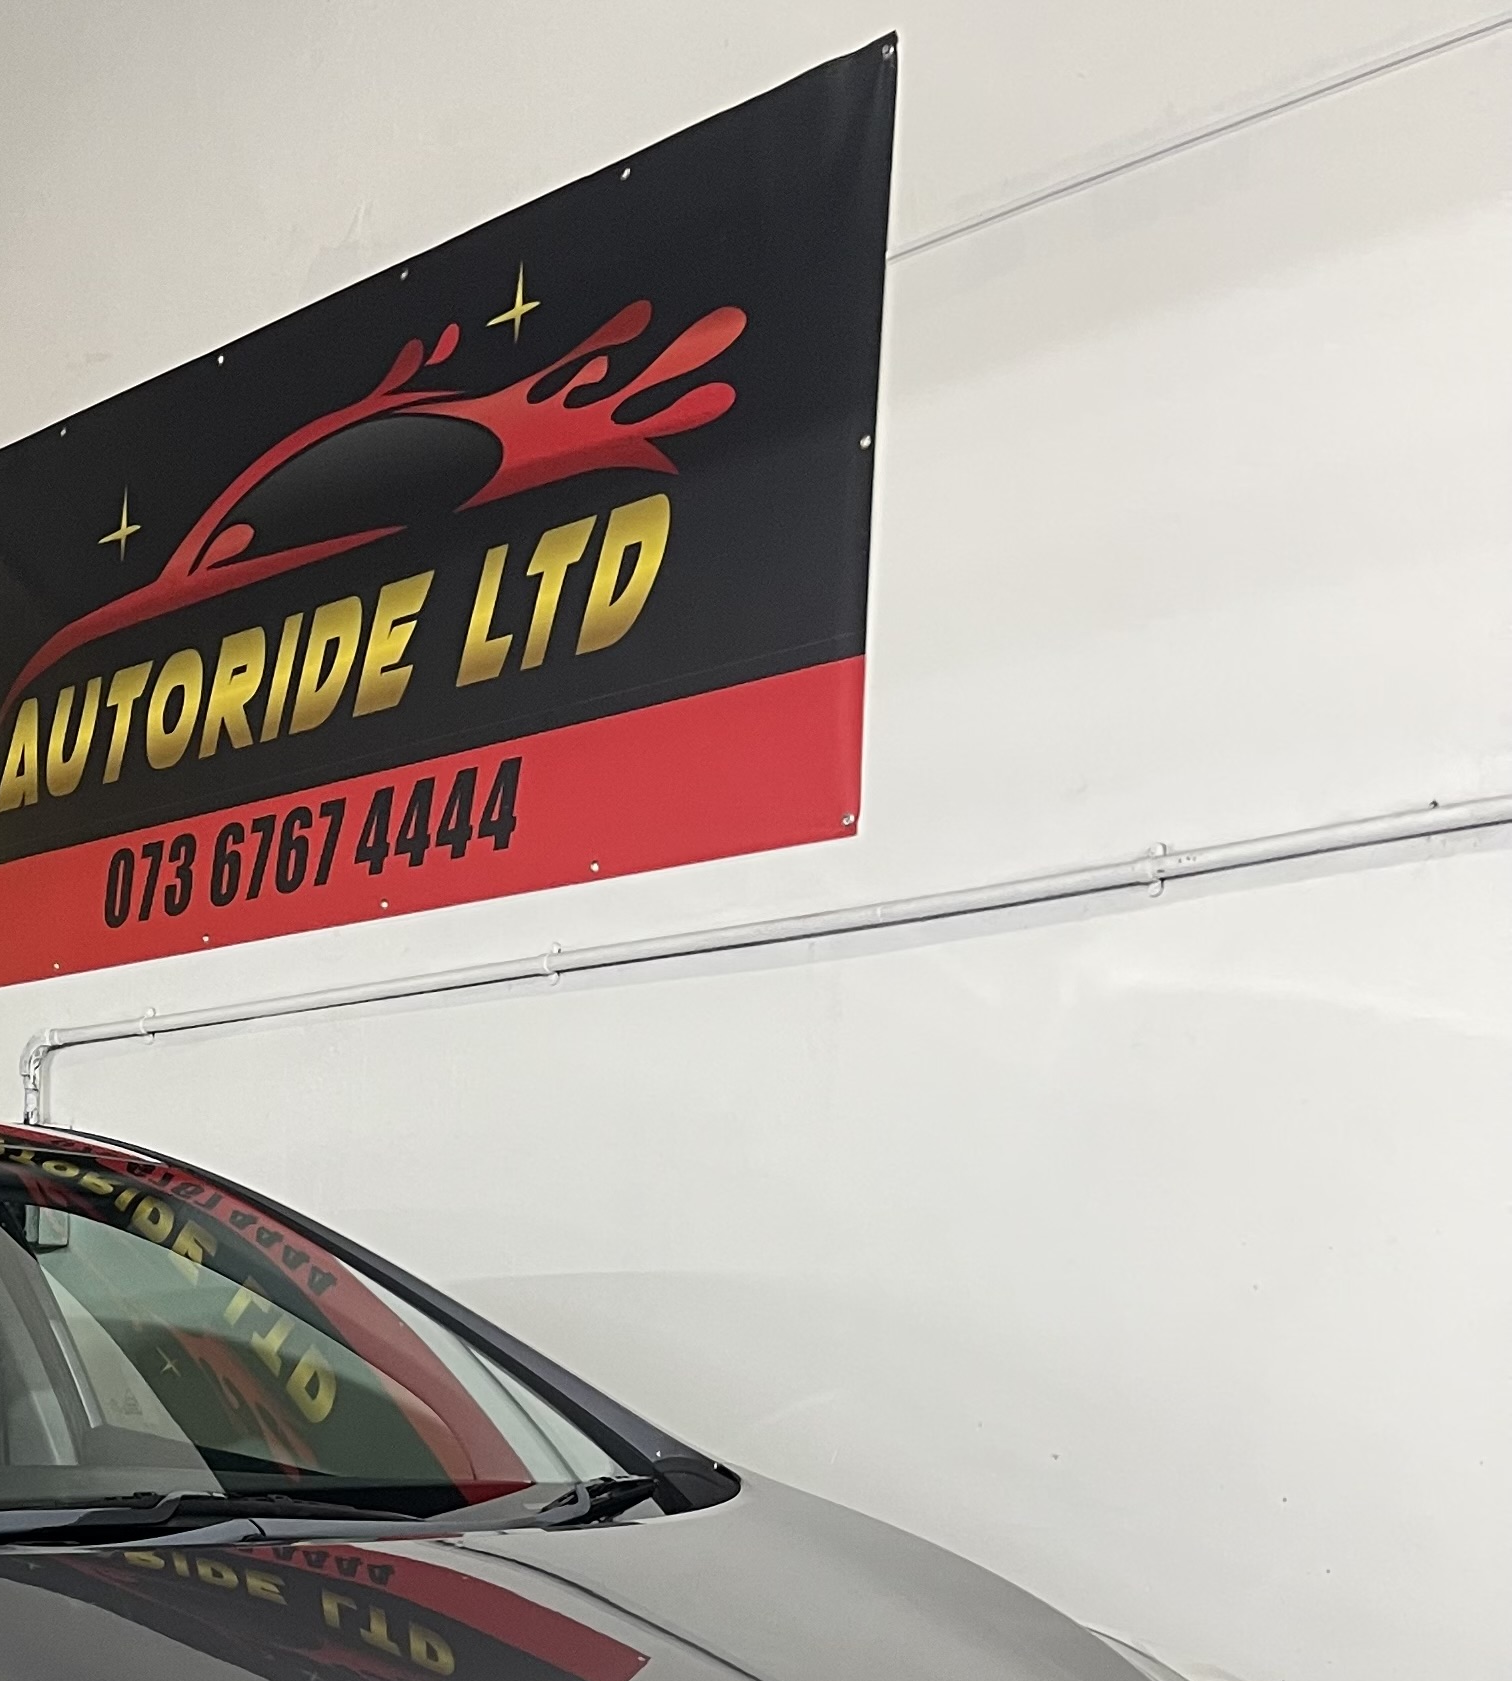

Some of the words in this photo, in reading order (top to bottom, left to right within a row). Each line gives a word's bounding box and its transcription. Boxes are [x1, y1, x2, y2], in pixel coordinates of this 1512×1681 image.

[455, 494, 672, 687] LTD
[104, 833, 194, 929] 073
[210, 800, 346, 907] 6767
[355, 758, 522, 874] 4444
